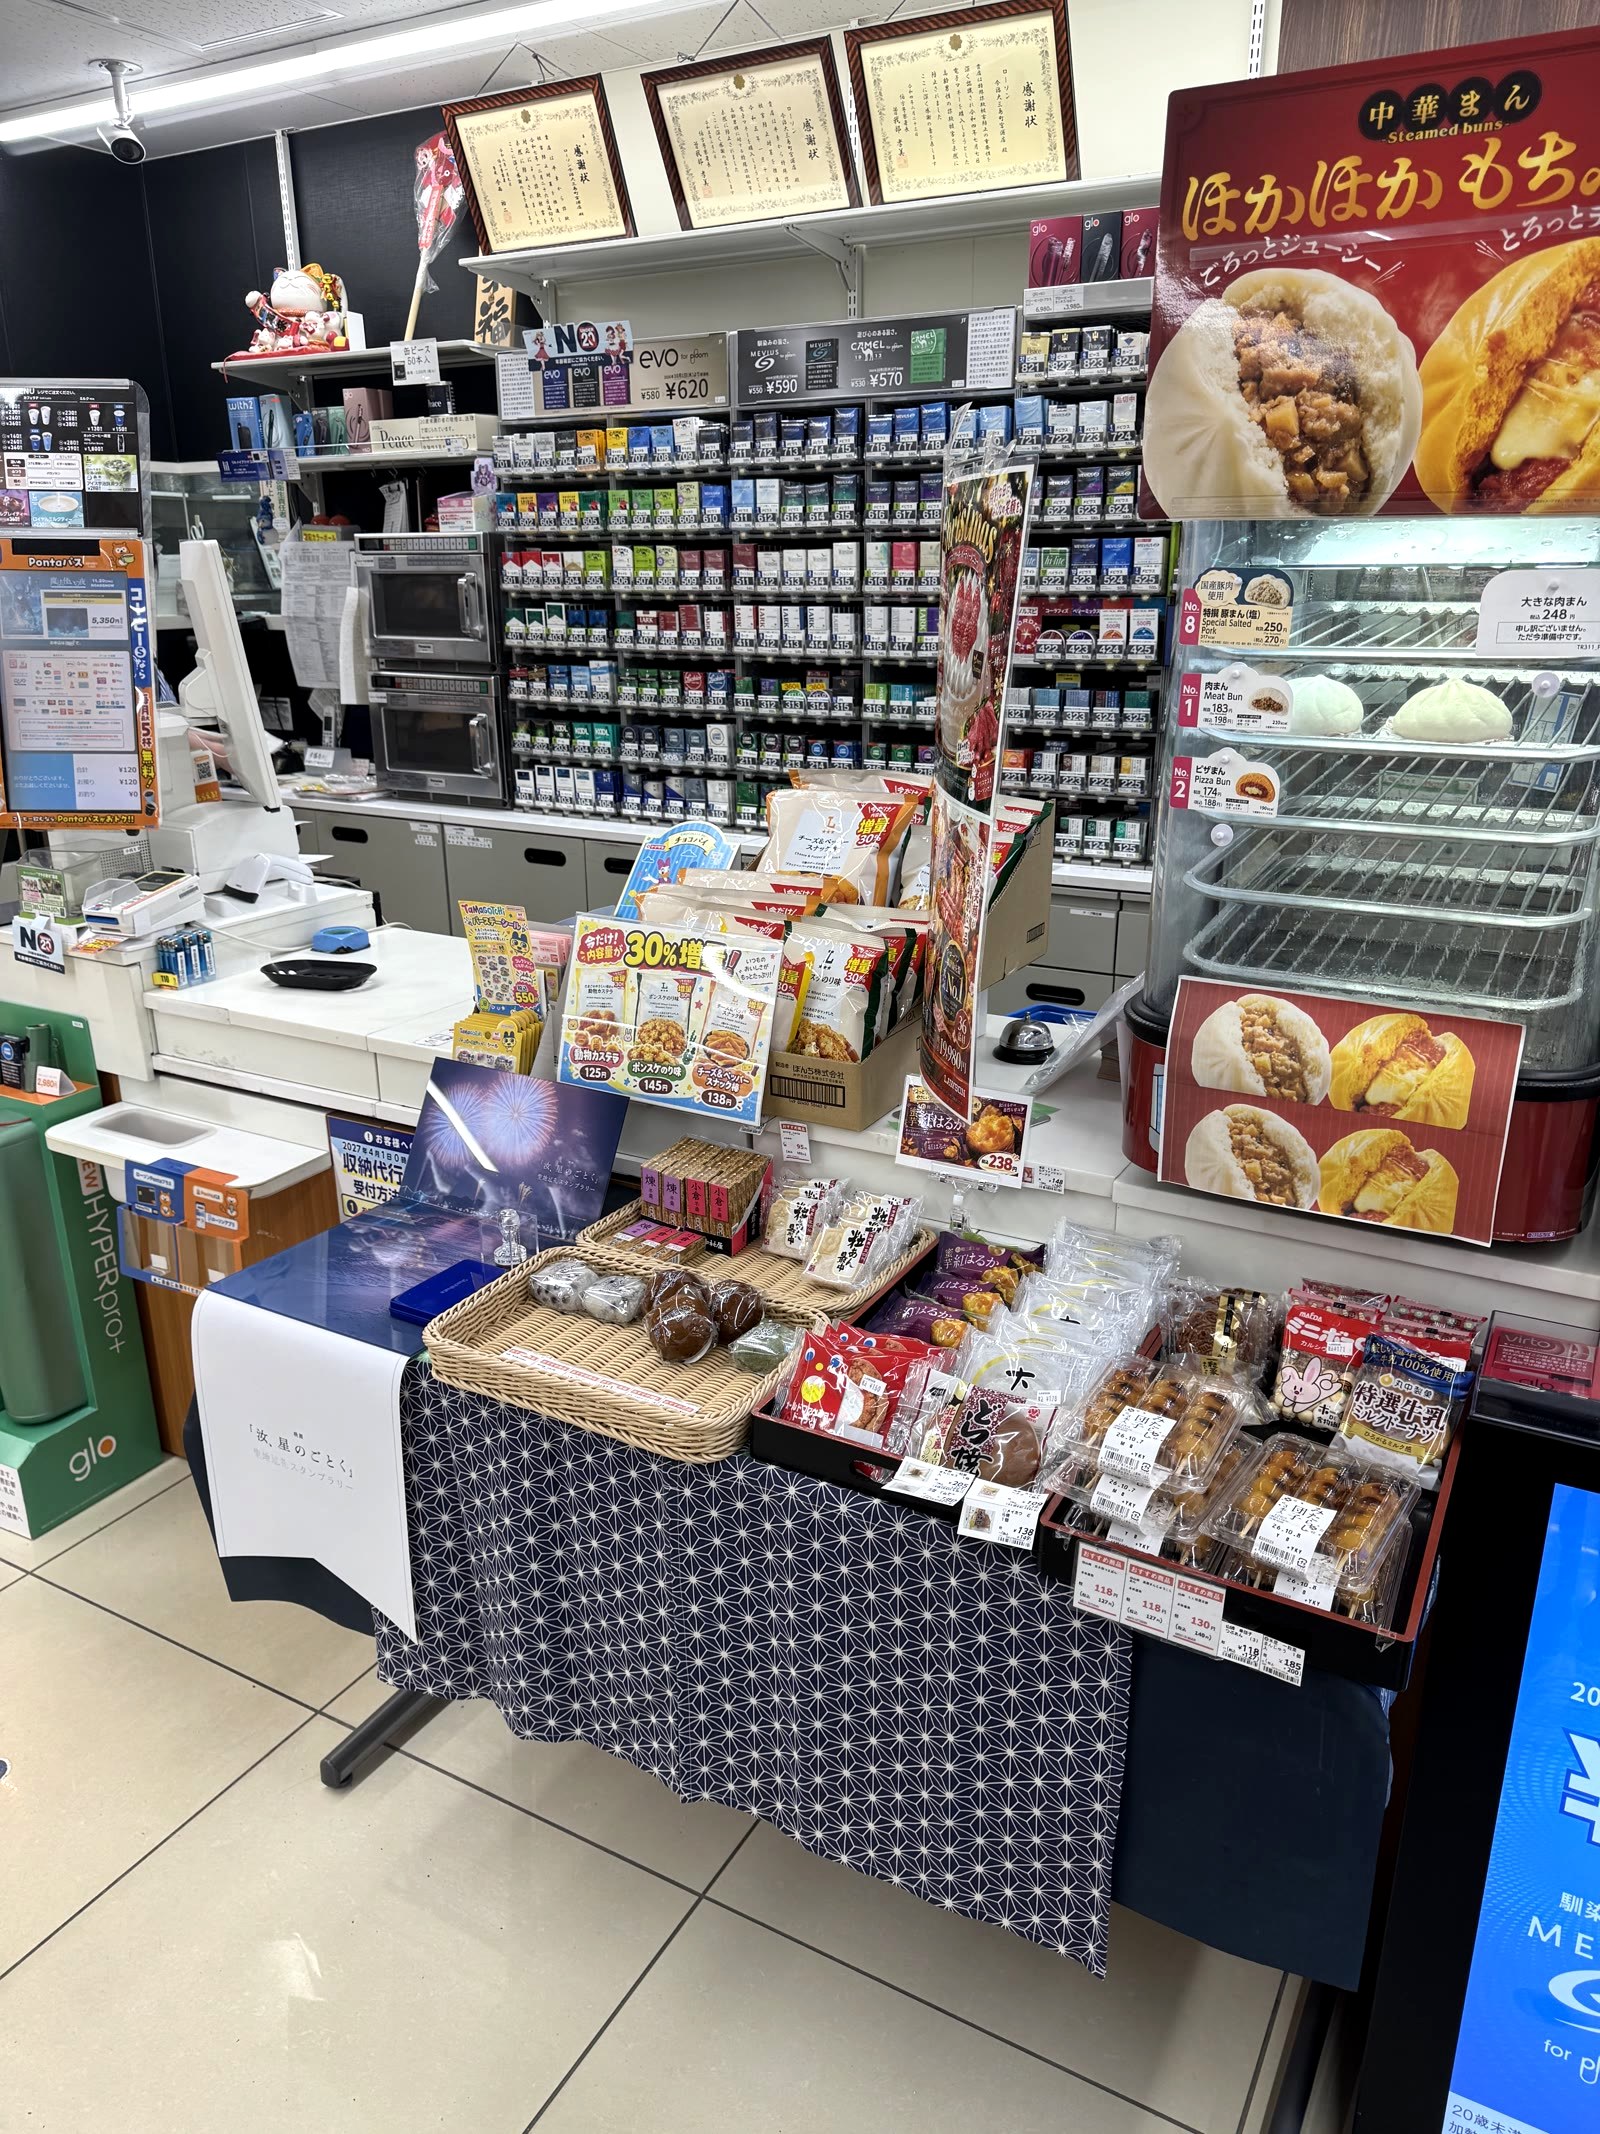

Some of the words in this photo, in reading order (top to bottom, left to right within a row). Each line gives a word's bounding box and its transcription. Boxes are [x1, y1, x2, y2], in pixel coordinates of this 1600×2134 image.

[1002, 68, 1010, 99] ローソン
[1022, 82, 1037, 128] 感謝状
[1368, 84, 1531, 130] 中華まん
[802, 118, 820, 159] 感謝状
[1387, 121, 1459, 144] Steamed
[573, 144, 590, 184] 感謝状
[1181, 155, 1444, 241] ほかほか
[1084, 217, 1100, 231] glo
[1123, 213, 1140, 228] glo
[1032, 223, 1048, 237] glo
[809, 341, 832, 349] MEVIUS
[911, 331, 936, 345] CAMEL
[403, 343, 431, 357] 缶ピース
[850, 340, 885, 352] CAMEL
[406, 354, 431, 366] 50本入
[639, 347, 679, 369] evo
[750, 349, 780, 358] MEVIUS
[1021, 362, 1040, 372] 821
[1083, 359, 1104, 369] 823
[1115, 357, 1137, 367] 824
[543, 369, 561, 379] evo
[573, 366, 591, 377] evo
[603, 364, 621, 375] evo
[869, 371, 902, 388] ¥570
[641, 390, 661, 400] ¥580
[665, 378, 709, 400] ¥620
[766, 379, 798, 395] ¥590
[378, 429, 415, 450] Peace
[1019, 435, 1037, 445] 721
[1080, 433, 1100, 442] 723
[1111, 431, 1131, 441] 724
[924, 441, 941, 450] 718
[1047, 506, 1067, 515] 622
[1108, 504, 1129, 513] 624
[28, 555, 84, 569] Pontaパス
[867, 577, 884, 586] 516
[1042, 577, 1062, 585] 522
[1104, 576, 1124, 584] 524
[1135, 575, 1156, 584] 525
[1200, 580, 1234, 592] 国産豚肉
[1207, 590, 1225, 601] 使用
[1520, 596, 1589, 608] 大きな肉まん
[1184, 601, 1199, 612] No.
[1184, 614, 1196, 634] 8
[1200, 625, 1217, 636] Pork
[1202, 617, 1228, 629] Special
[1228, 618, 1252, 630] Salted
[1515, 623, 1588, 633] 申し訳ございません。
[1517, 632, 1584, 642] ただ今準備中です。
[1038, 644, 1059, 653] 422
[1182, 684, 1199, 696] No.
[1204, 681, 1229, 692] 肉まん
[1203, 691, 1225, 702] Meat
[1225, 691, 1243, 703] Bun
[1008, 709, 1025, 718] 321
[1184, 698, 1194, 718] 1
[1125, 714, 1146, 722] 325
[117, 765, 137, 774] ¥120
[1173, 766, 1190, 778] No.
[1194, 764, 1226, 777] ピザまん
[118, 777, 138, 786] ¥120
[1121, 780, 1141, 788] 225
[1193, 774, 1215, 786] Pizza
[1215, 775, 1232, 788] Bun
[128, 789, 139, 798] ¥0
[1174, 780, 1186, 799] 2
[858, 817, 890, 835] 増量
[674, 832, 709, 855] チョコパイ
[858, 833, 882, 845] 30%
[1058, 839, 1077, 847] 123
[585, 931, 619, 950] 今だけ!
[586, 944, 624, 961] 内容量が
[624, 930, 741, 977] 30%増!
[845, 956, 872, 974] 増量
[842, 972, 867, 985] 30%
[515, 991, 535, 1004] 550
[573, 1047, 620, 1063] 動物カステラ
[584, 1067, 608, 1080] 125円
[696, 1067, 750, 1085] チーズ&ペッパー
[644, 1079, 668, 1093] 145円
[706, 1077, 740, 1093] スナック棒
[707, 1092, 733, 1107] 138円
[342, 1152, 405, 1186] 収納代行
[953, 1250, 1000, 1269] 紅はるか
[1504, 1333, 1552, 1349] Virto
[1380, 1352, 1455, 1383] 牛乳100%使用
[1394, 1378, 1433, 1398] 丸中製菓
[1353, 1382, 1447, 1431] 特選牛乳
[1350, 1404, 1435, 1443] ミルクドーナツ
[1116, 1431, 1145, 1446] 26.10.7
[1363, 1429, 1413, 1454] ひろがるミルク感
[69, 1434, 117, 1482] glo
[1108, 1477, 1137, 1494] 26.10.7
[1013, 1525, 1034, 1538] ¥138
[1271, 1522, 1302, 1539] 26.10.8
[1082, 1550, 1125, 1570] おすすめ商品
[1130, 1565, 1173, 1585] おすすめ商品
[1094, 1583, 1118, 1597] 118円
[1286, 1576, 1318, 1591] 26.10.8
[1178, 1581, 1222, 1603] おすすめ商品
[1142, 1599, 1166, 1615] 118円
[1190, 1615, 1216, 1632] 130円
[1544, 2038, 1572, 2063] for
